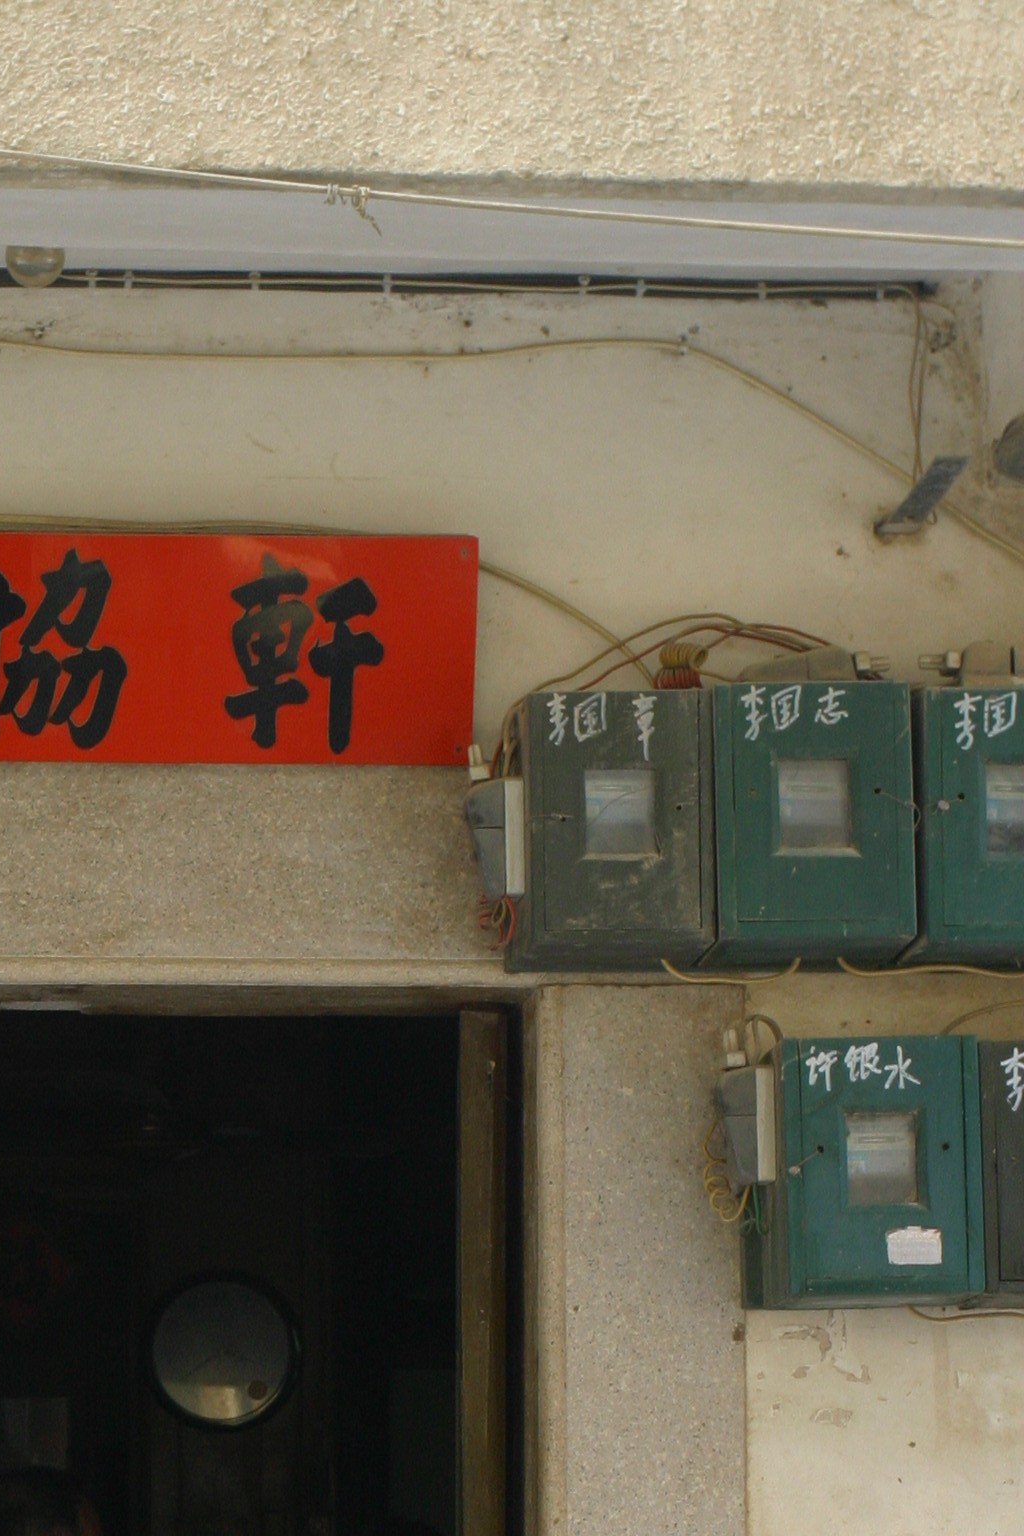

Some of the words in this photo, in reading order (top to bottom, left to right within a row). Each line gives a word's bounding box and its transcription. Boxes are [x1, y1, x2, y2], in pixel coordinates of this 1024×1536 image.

[740, 684, 849, 741] 李国志
[953, 691, 1018, 751] 李国
